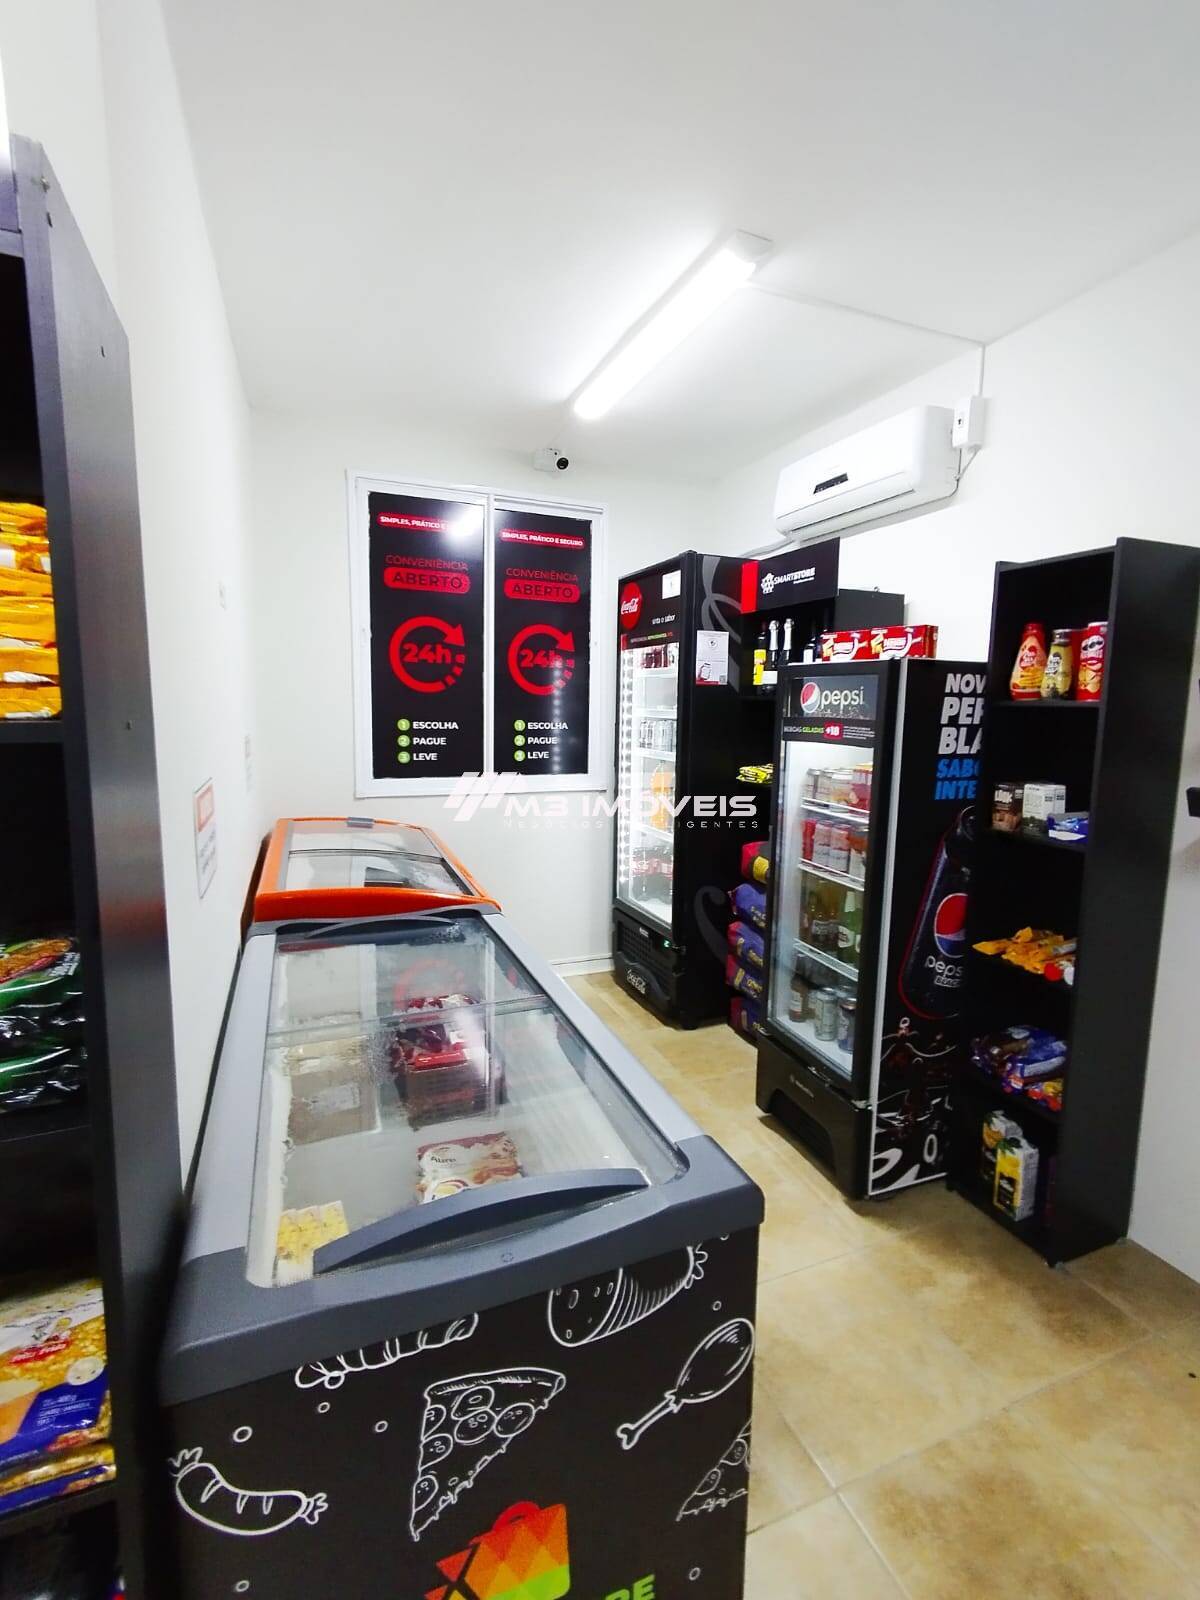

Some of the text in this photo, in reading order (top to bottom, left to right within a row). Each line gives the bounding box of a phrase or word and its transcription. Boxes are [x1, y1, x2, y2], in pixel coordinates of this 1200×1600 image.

[392, 571, 463, 589] ABERTO
[512, 582, 573, 598] ABERTO
[403, 643, 452, 664] 24h
[520, 649, 563, 669] 24h
[821, 685, 865, 714] pepsi
[412, 721, 459, 730] ESCOLHA
[527, 722, 569, 730] ESCOLHA
[412, 736, 447, 745] PAGUE
[527, 736, 559, 745] PAGUE
[412, 752, 438, 761] LEVE
[527, 751, 550, 759] LEVE
[936, 758, 980, 778] SAB
